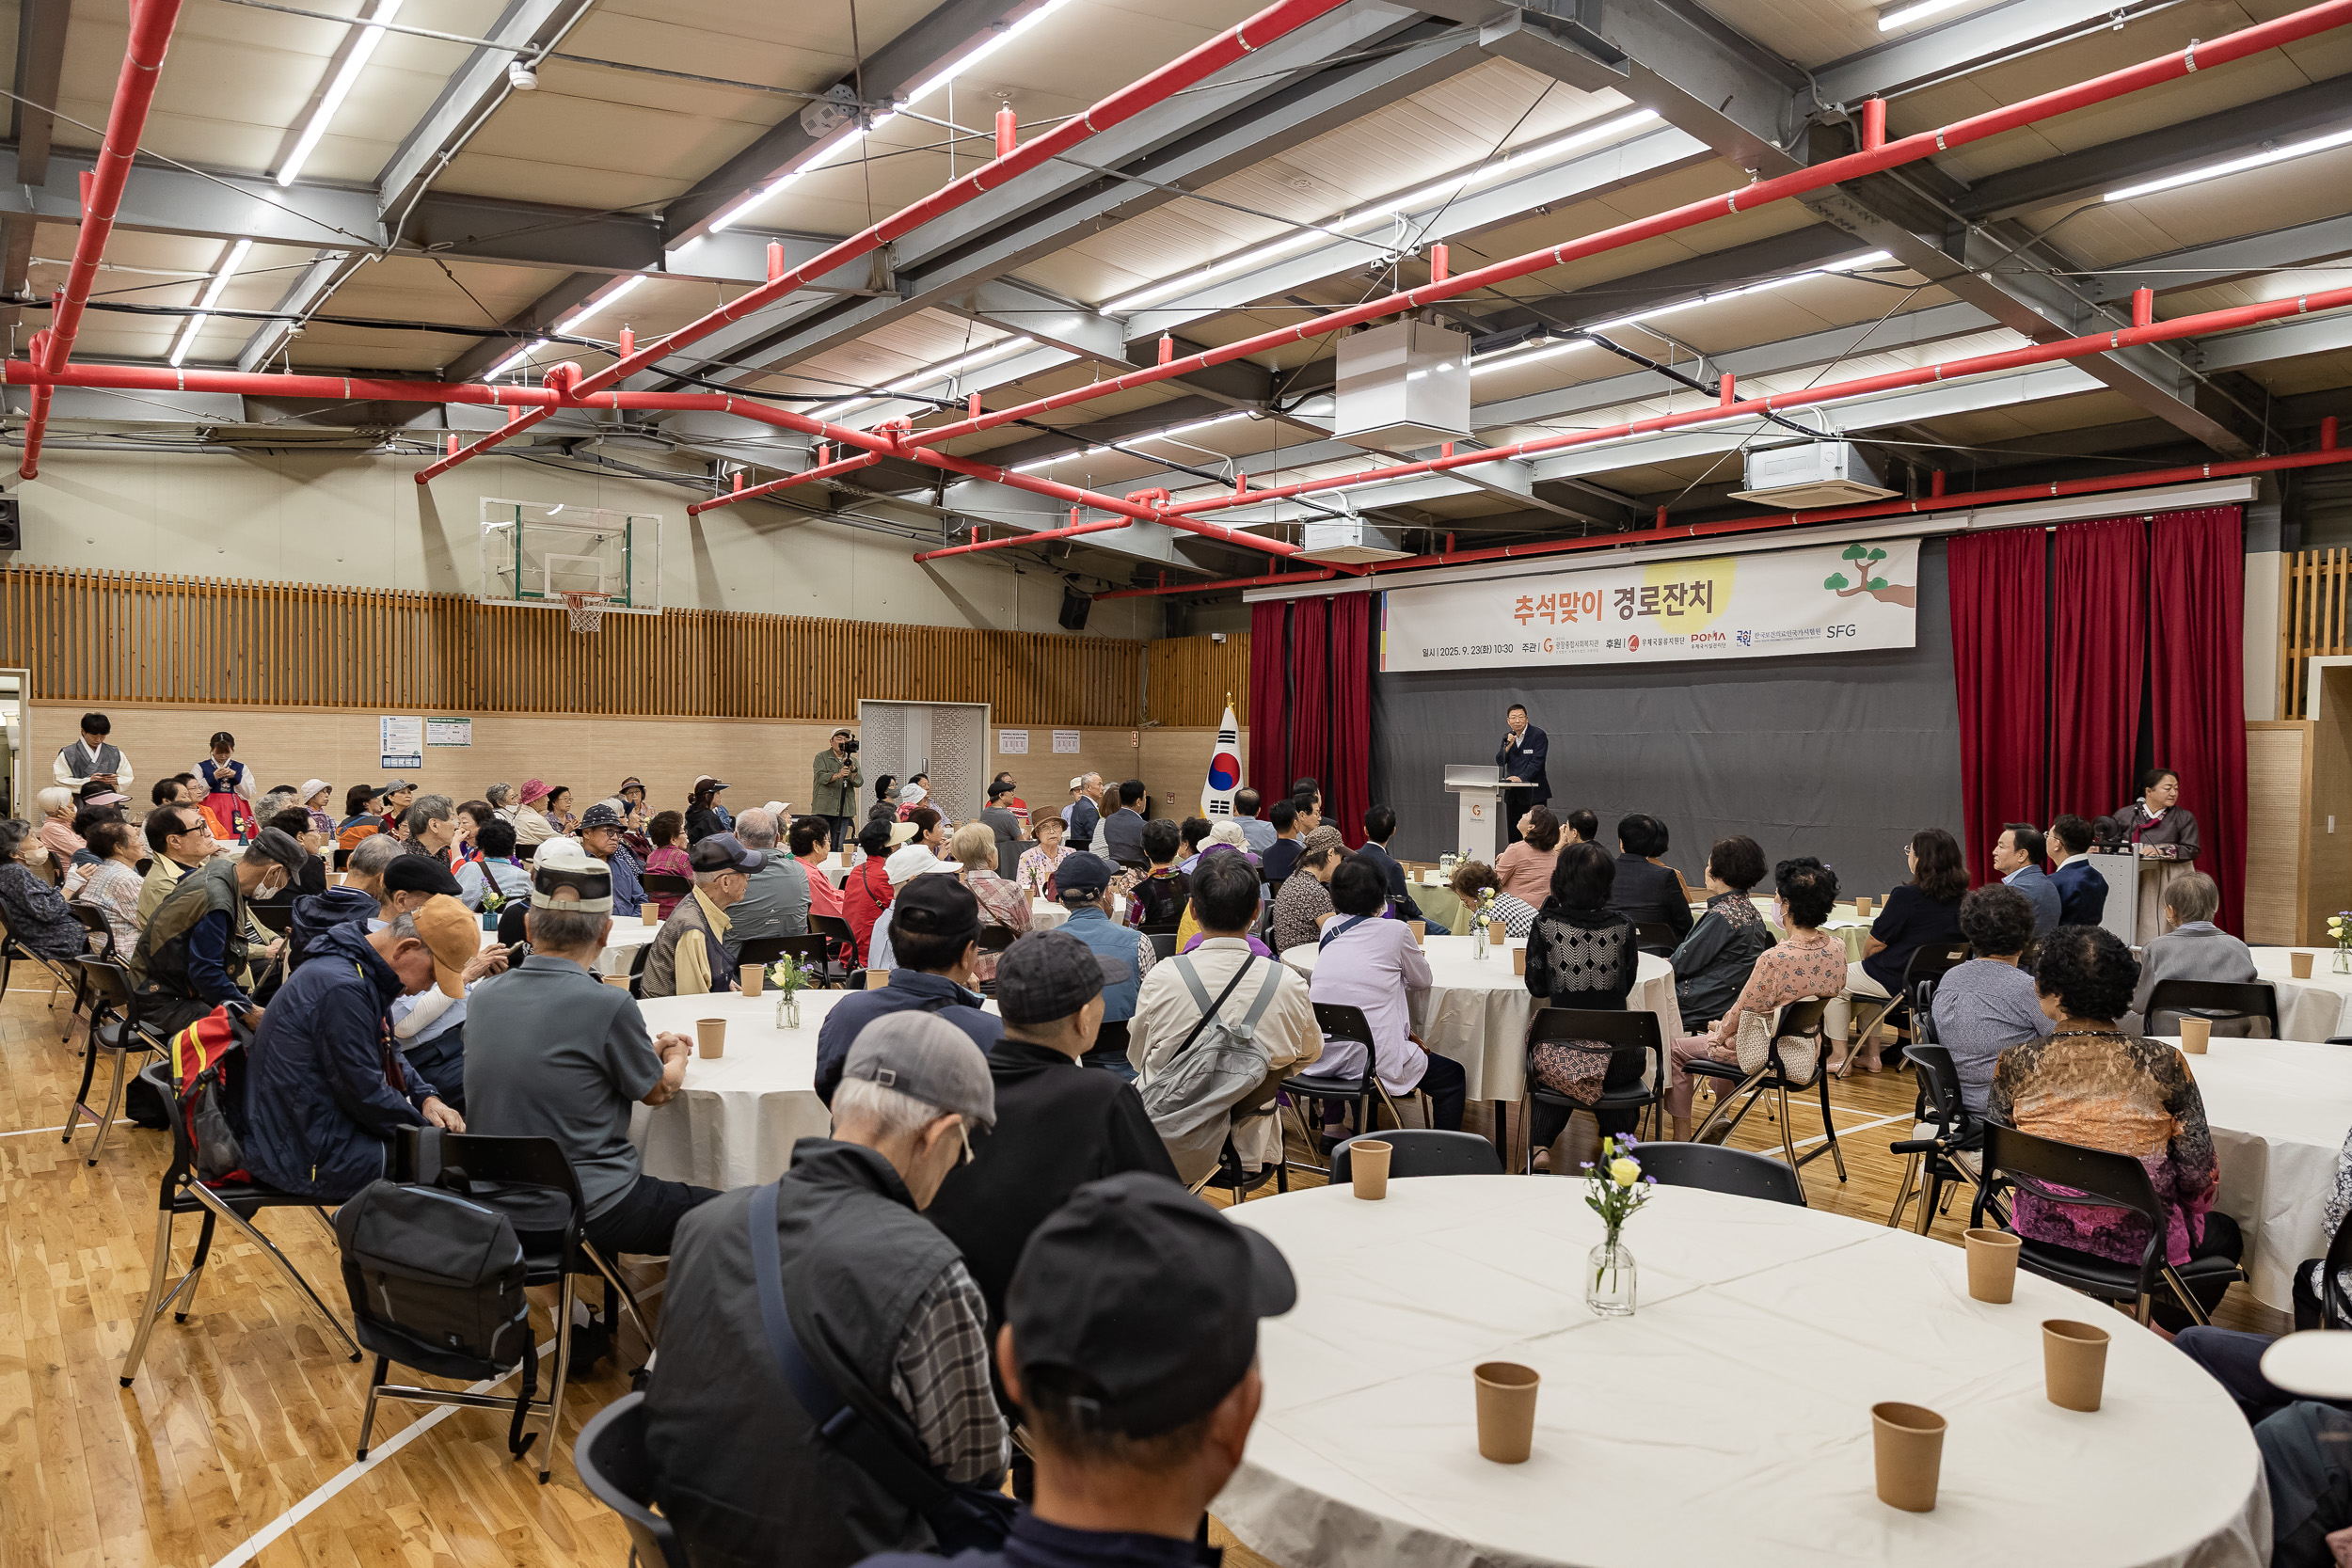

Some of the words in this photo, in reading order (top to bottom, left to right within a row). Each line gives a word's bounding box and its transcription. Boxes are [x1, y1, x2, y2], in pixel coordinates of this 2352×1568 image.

[1514, 590, 1603, 626] 추석맞이
[1613, 579, 1713, 621] 경로잔치
[1691, 631, 1726, 642] POMA
[1754, 627, 1821, 640] 한국보건의료인국가시험원
[1826, 624, 1856, 639] SFG
[1605, 638, 1622, 649] 후원
[1641, 636, 1685, 647] 우체국물류지원단
[1422, 648, 1436, 657] 일시
[1439, 646, 1461, 657] 2025.
[1462, 646, 1470, 656] 9.
[1470, 644, 1492, 655] 23(화)
[1494, 643, 1514, 654] 10:30
[1521, 642, 1537, 653] 주관
